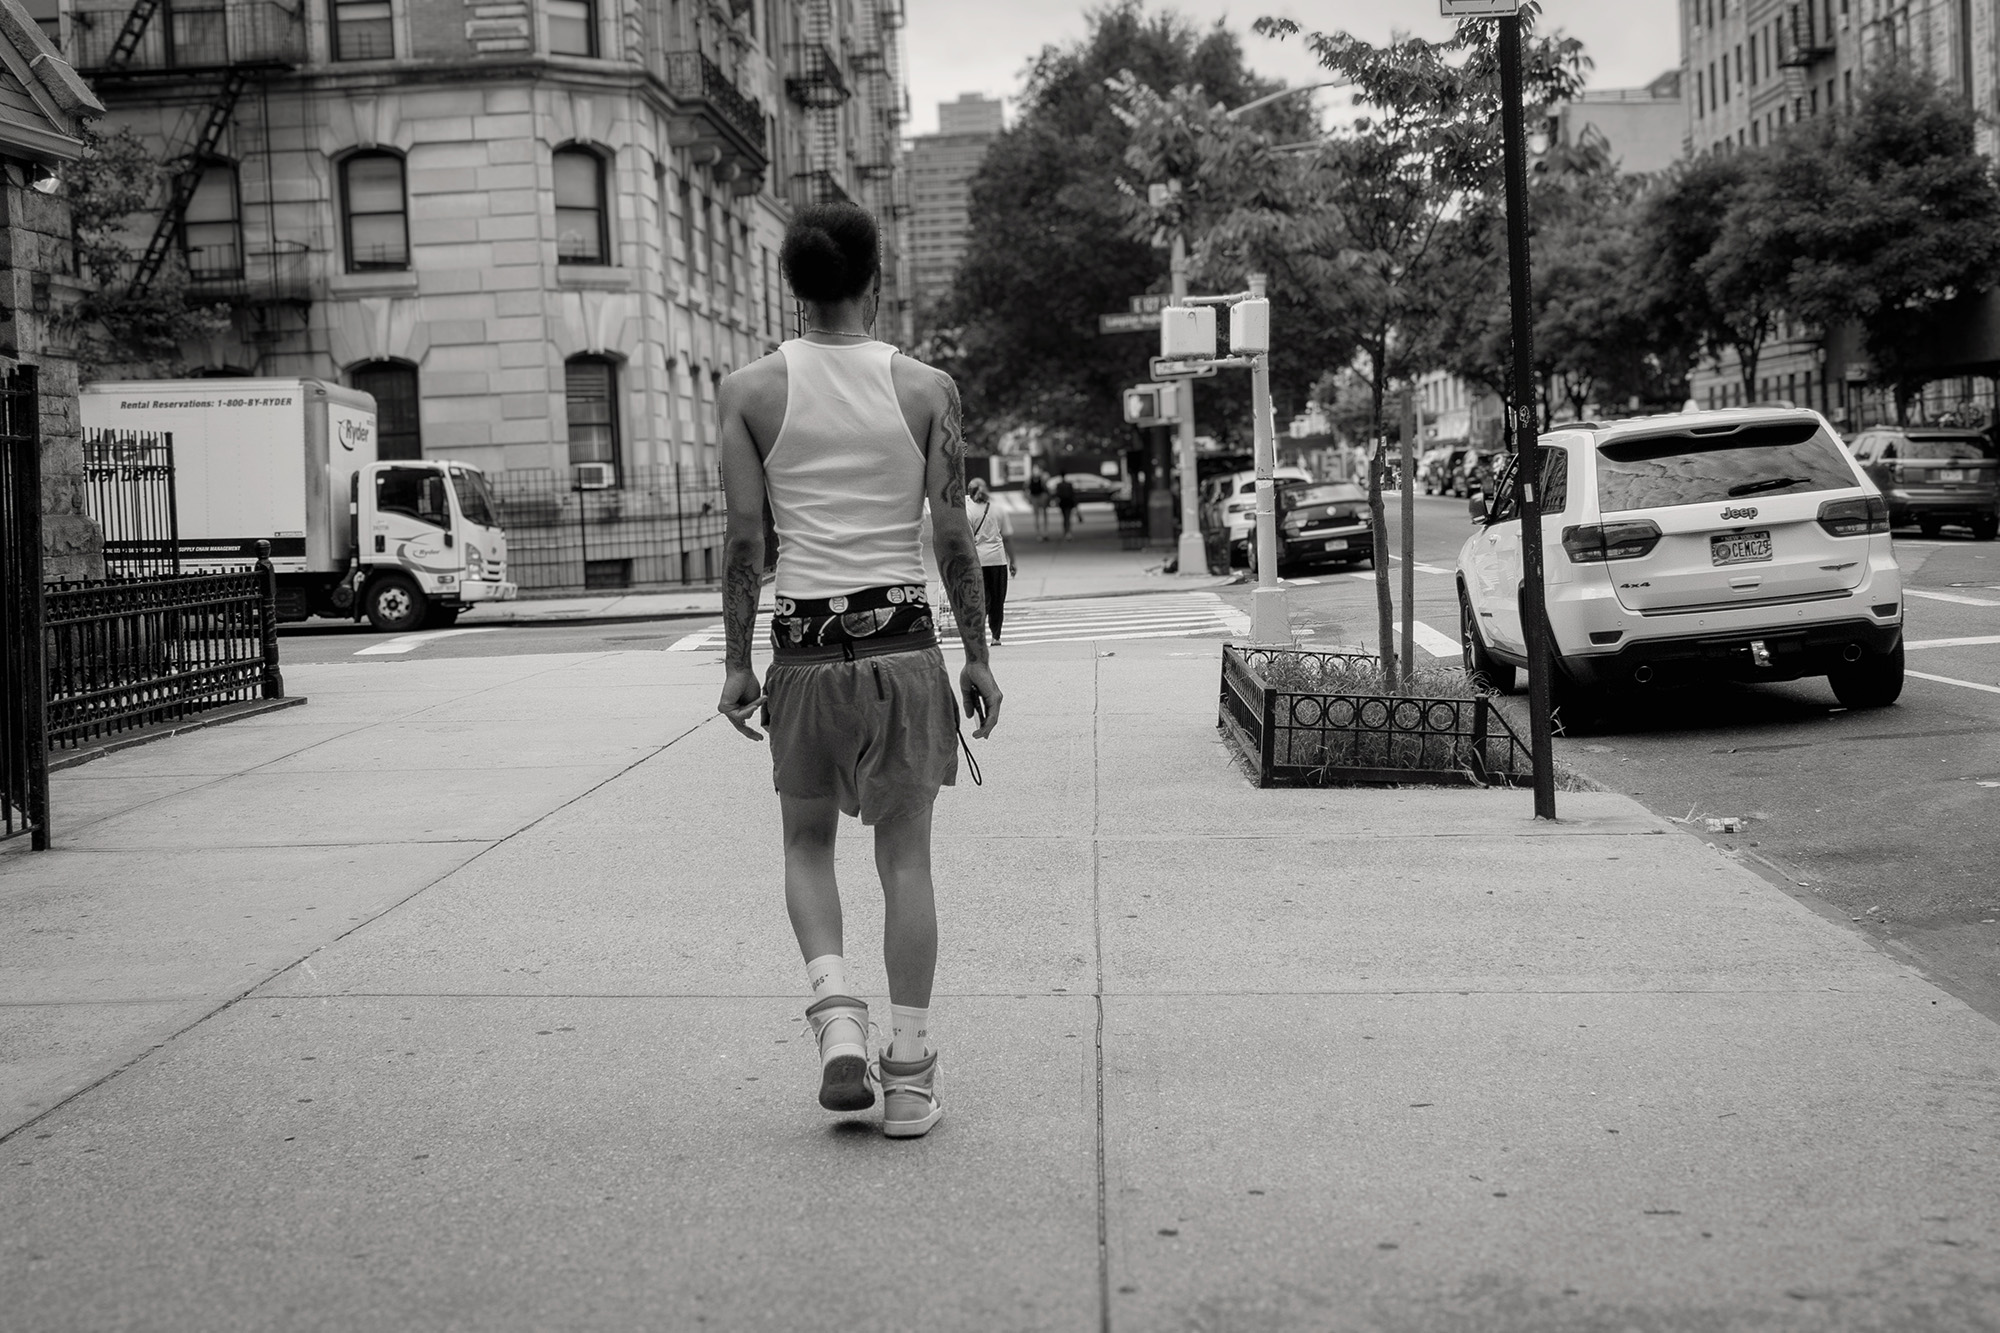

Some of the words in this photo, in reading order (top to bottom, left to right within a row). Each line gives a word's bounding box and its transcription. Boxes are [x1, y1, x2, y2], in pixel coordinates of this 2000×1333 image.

[120, 401, 150, 409] Rental
[152, 399, 214, 409] Reservations:
[217, 397, 292, 407] 1-800-BY-RYDER
[345, 419, 369, 445] Ryder
[1720, 507, 1758, 520] Jeep
